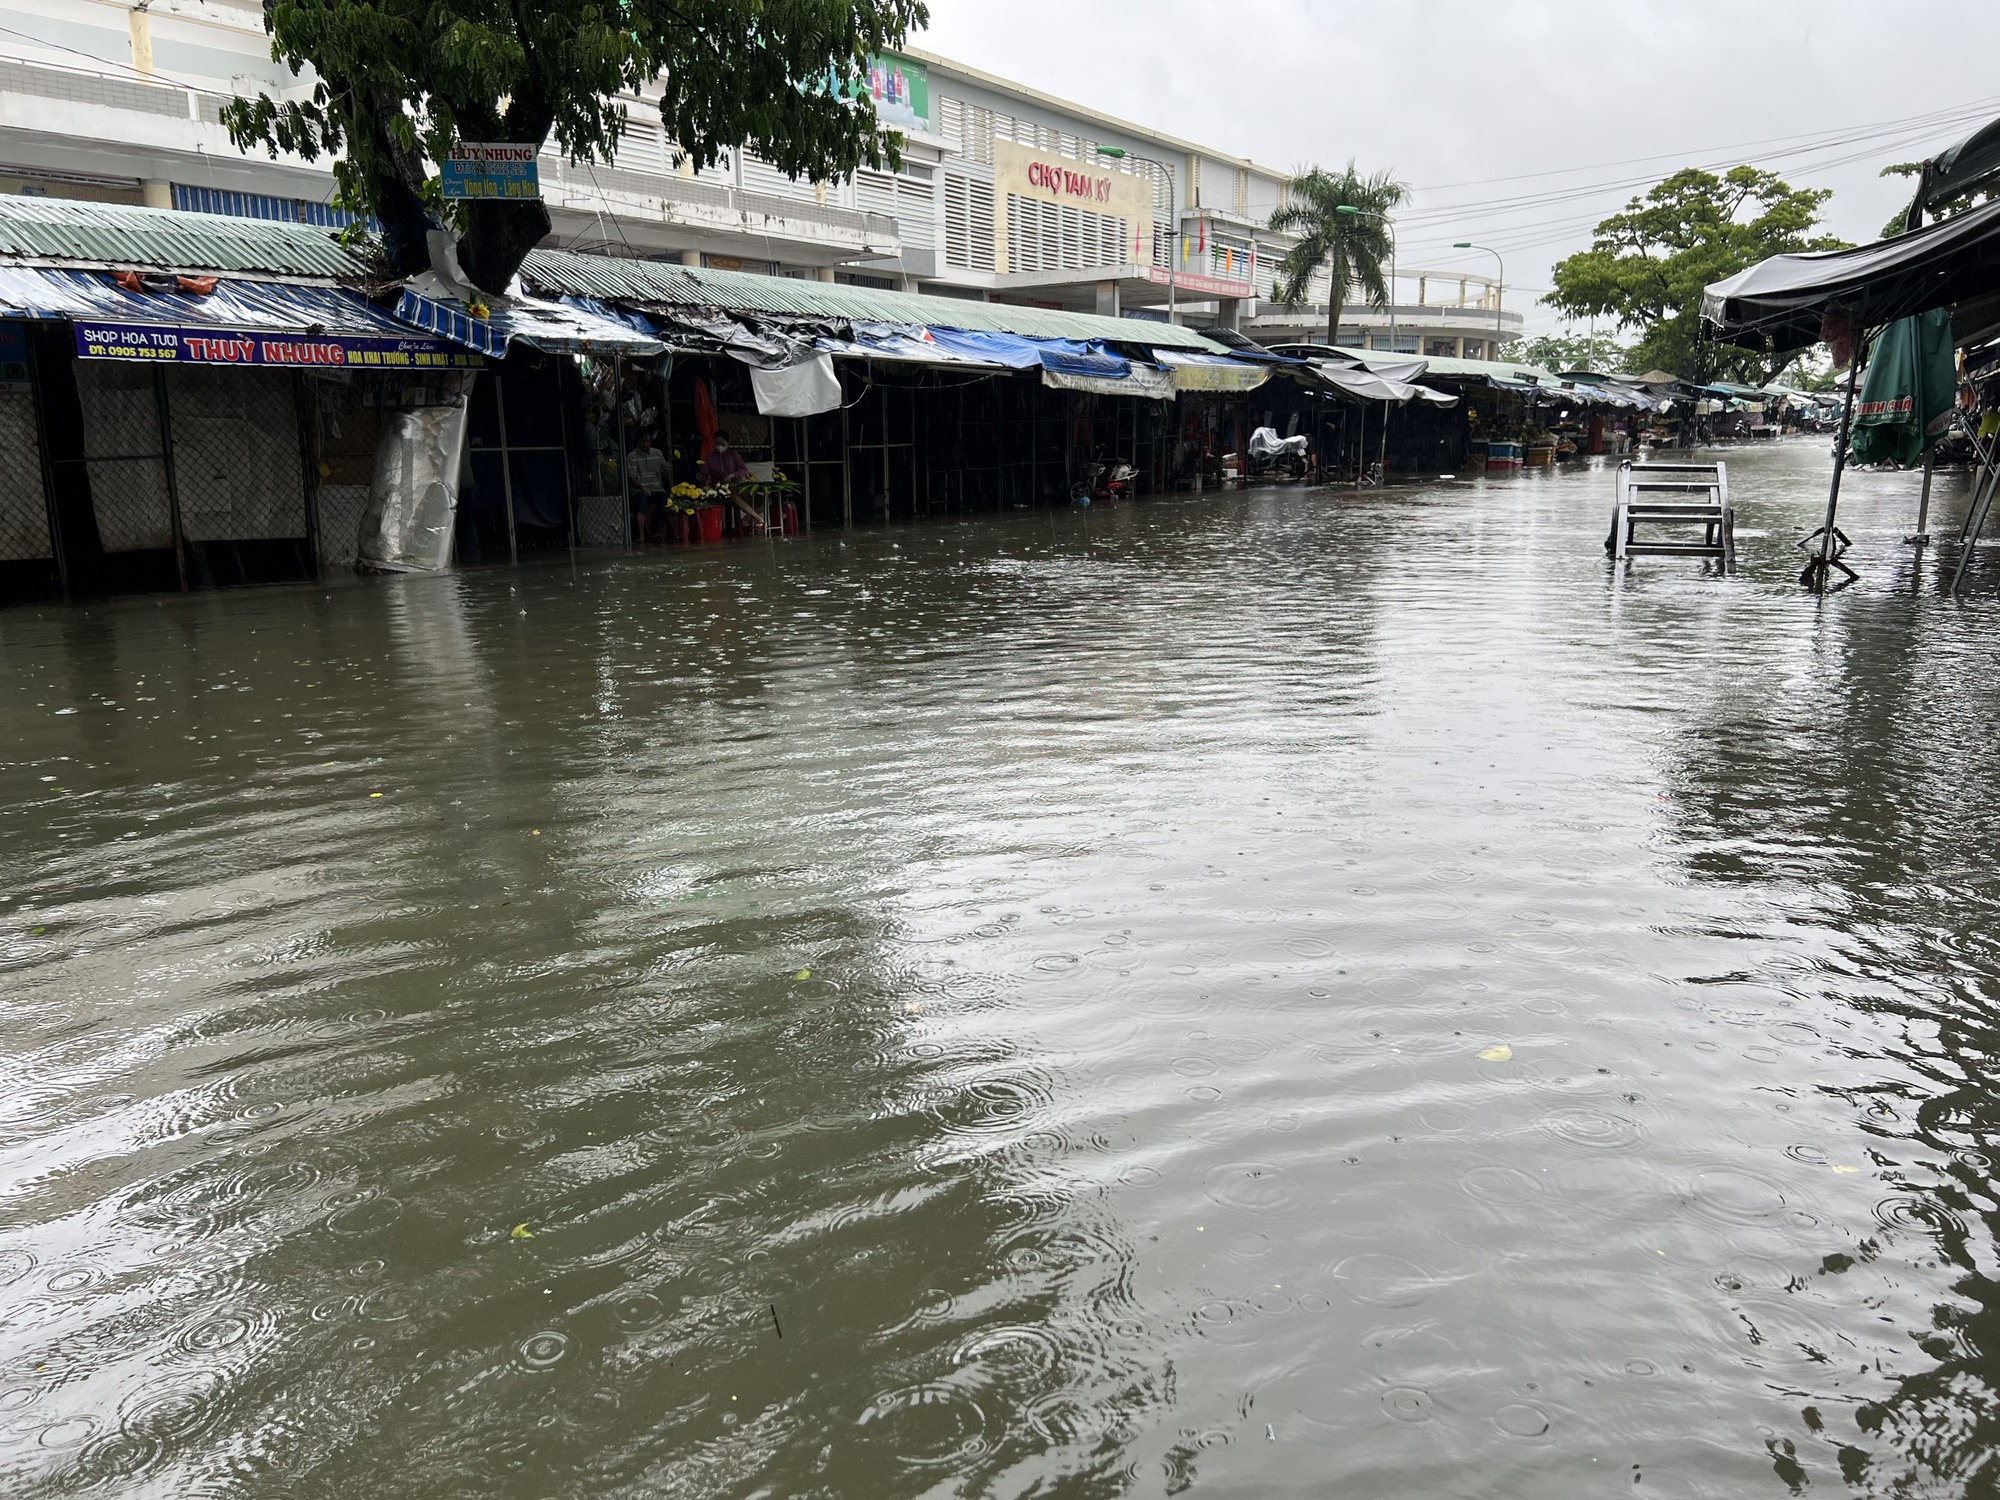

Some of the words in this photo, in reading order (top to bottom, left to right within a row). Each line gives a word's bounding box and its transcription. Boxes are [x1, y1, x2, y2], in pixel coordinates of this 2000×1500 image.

[449, 145, 480, 160] HÙY
[485, 148, 533, 161] NHUNG
[1028, 161, 1062, 195] CHỢ
[1064, 170, 1093, 199] TAM
[84, 329, 119, 344] SHOP
[121, 332, 149, 345] HOA
[89, 345, 107, 355] ĐT:
[108, 346, 137, 357] 0905
[138, 348, 157, 358] 753
[158, 349, 177, 359] 567
[262, 341, 346, 365] NHUNG
[347, 350, 364, 364] HOA
[364, 351, 382, 365] KHAI
[415, 352, 432, 366] SINH
[454, 354, 468, 366] HOA
